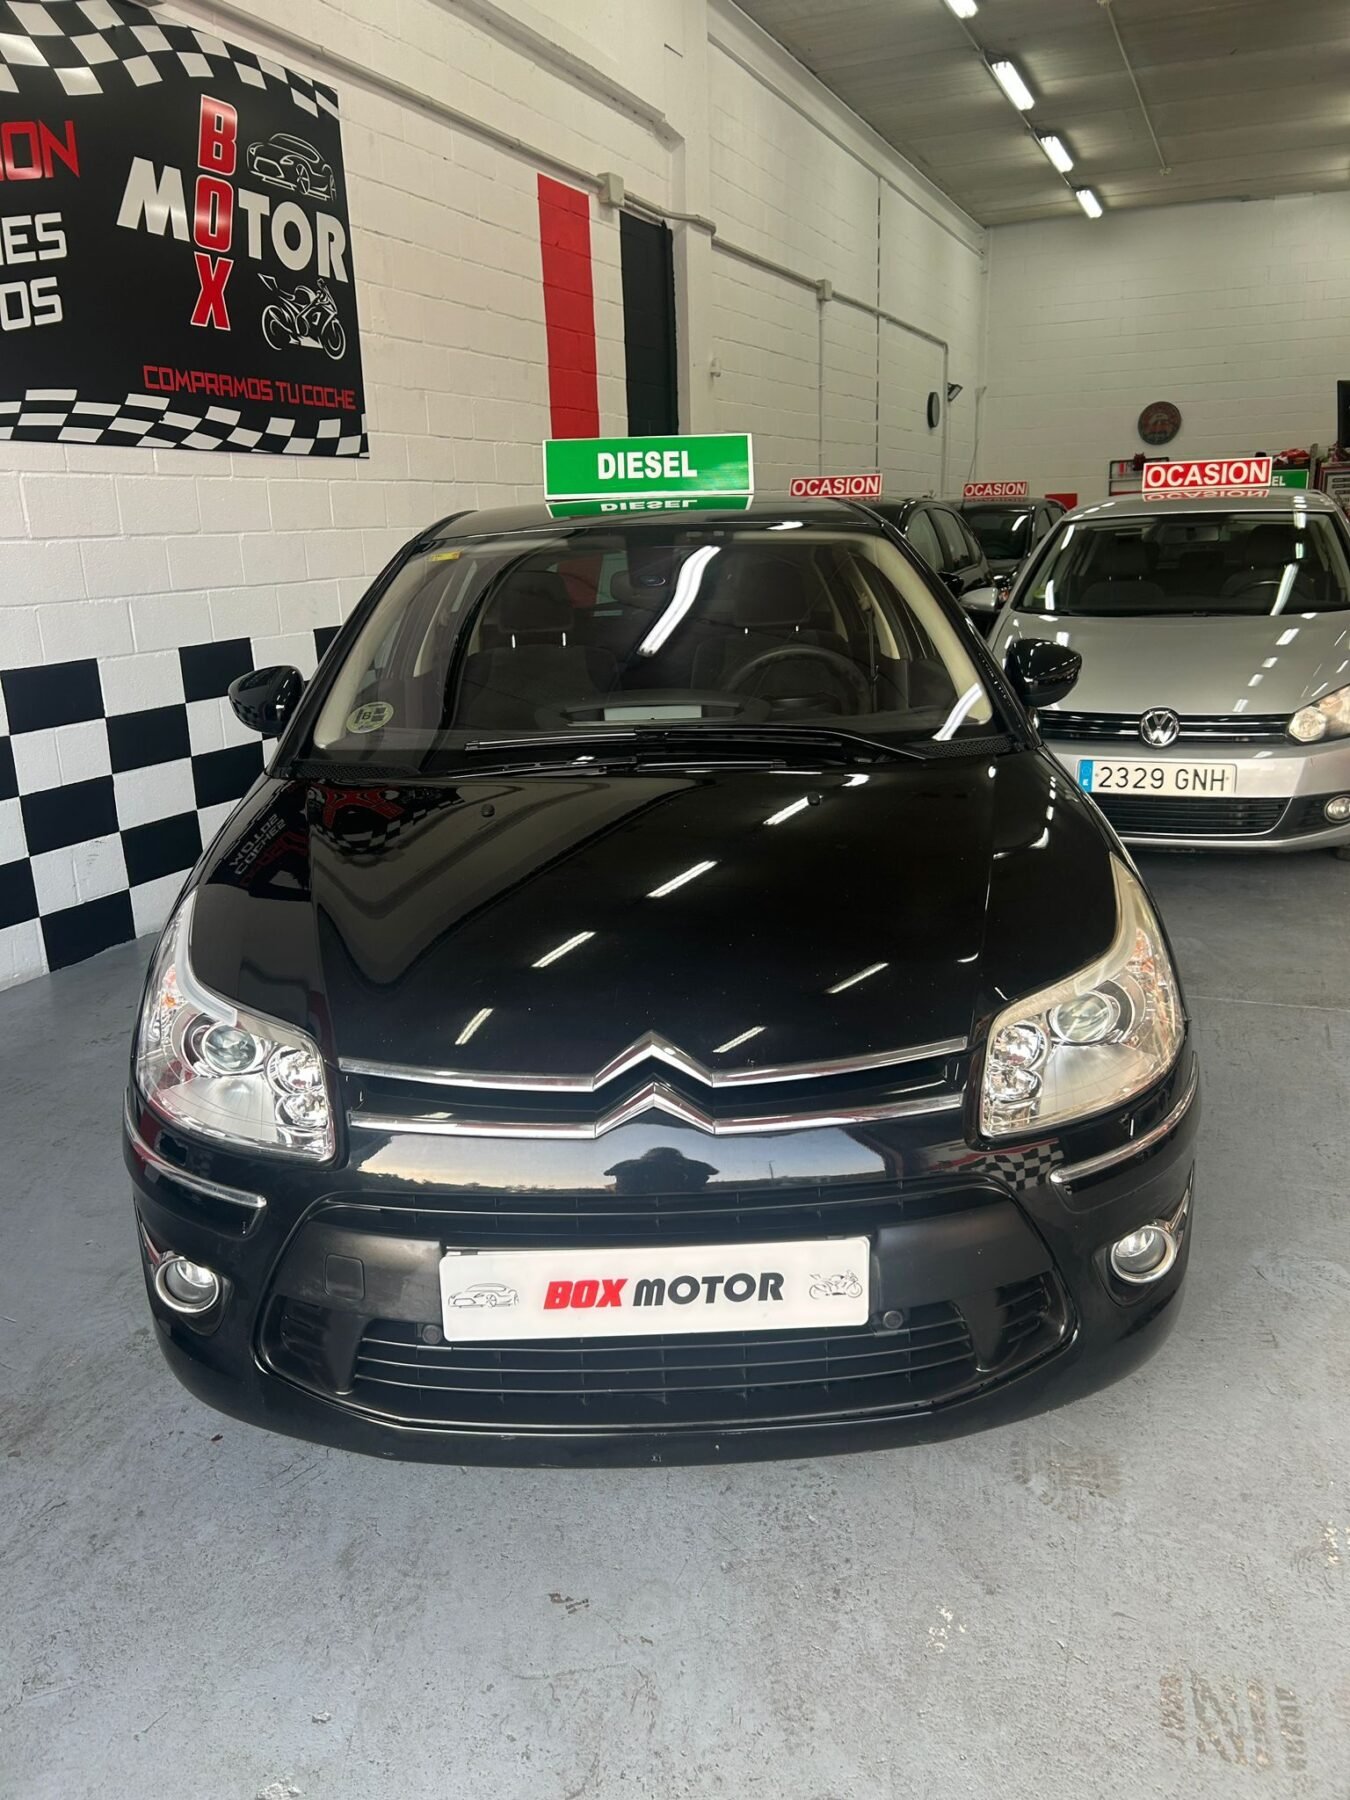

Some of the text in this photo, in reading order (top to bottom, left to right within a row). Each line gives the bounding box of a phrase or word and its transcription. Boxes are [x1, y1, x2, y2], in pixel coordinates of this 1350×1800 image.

[190, 94, 238, 331] BOX
[0, 212, 68, 265] ES
[143, 365, 356, 410] COMPRAMOS TU COCHE
[597, 450, 698, 480] DIESEL
[1146, 460, 1268, 488] OCASION
[791, 476, 879, 496] OCASION
[964, 482, 1025, 497] OCASION
[1098, 766, 1225, 791] 2329 GNH
[543, 1272, 785, 1310] BOX MOTOR
